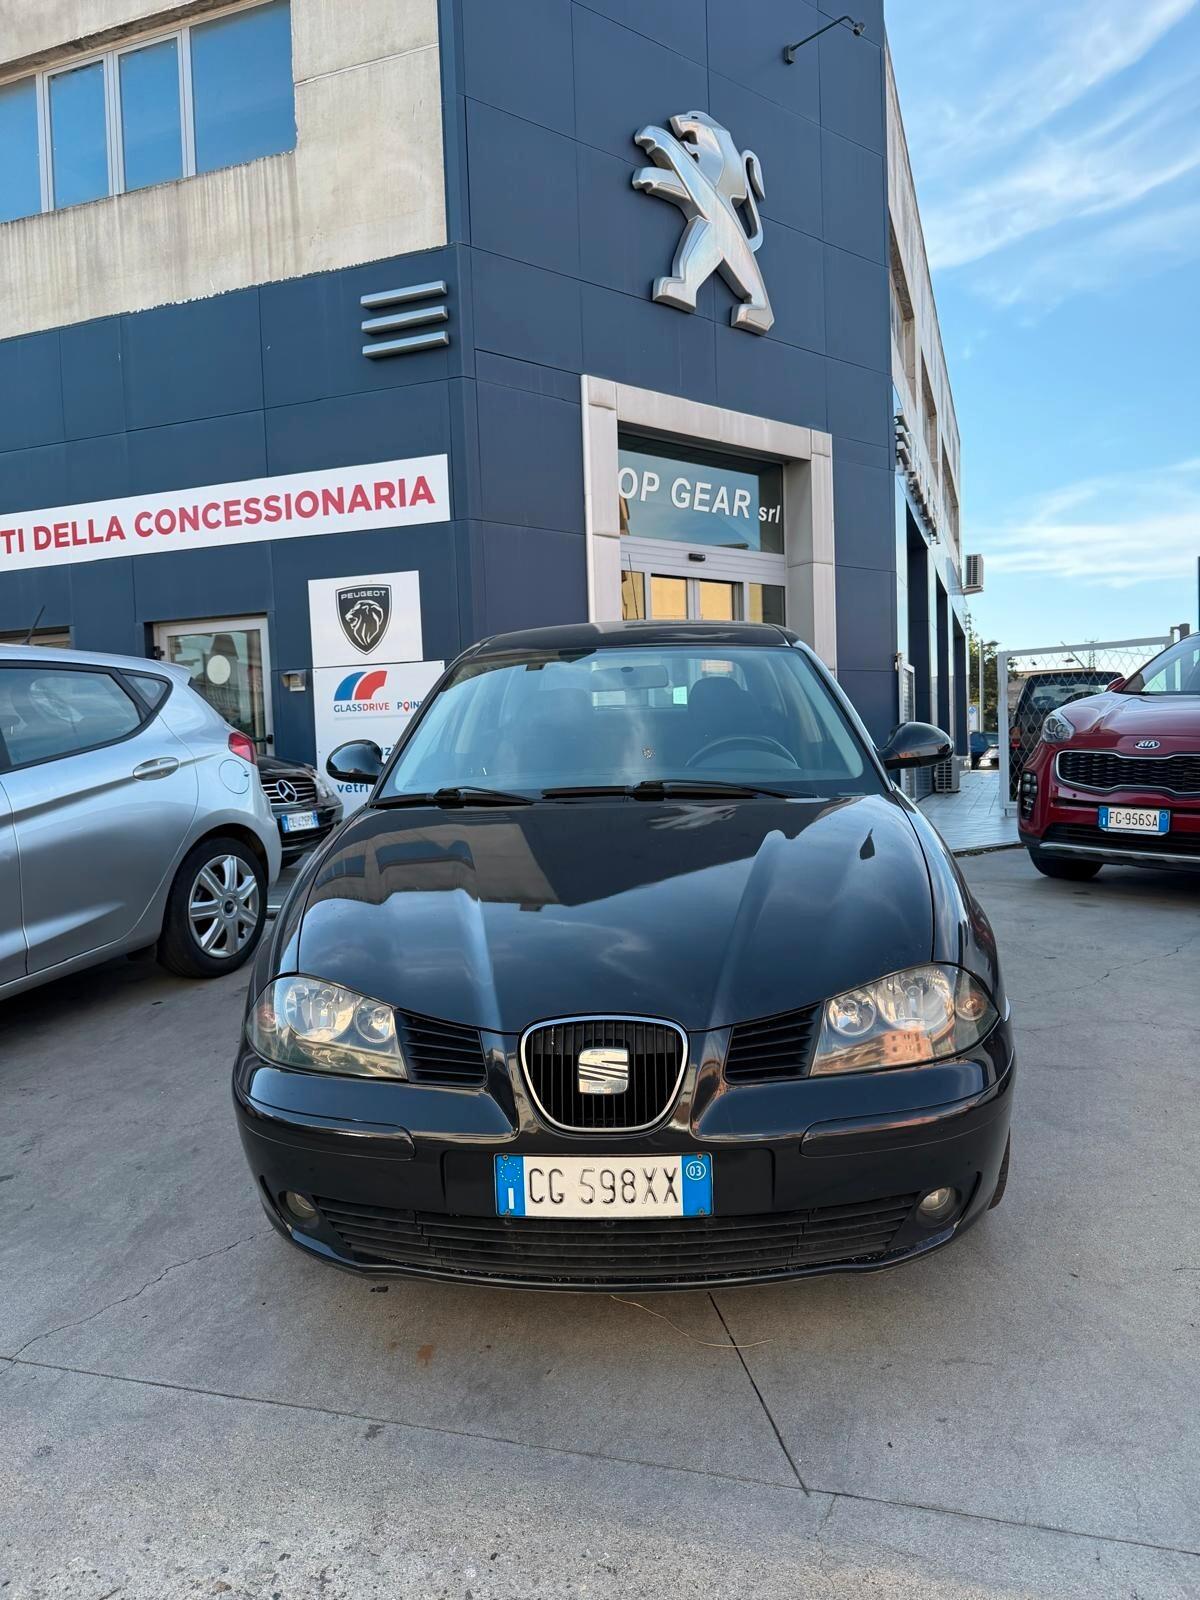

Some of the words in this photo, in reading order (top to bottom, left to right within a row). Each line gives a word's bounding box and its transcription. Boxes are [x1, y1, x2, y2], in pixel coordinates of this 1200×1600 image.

[671, 477, 751, 518] GEAR
[758, 505, 781, 523] srl
[33, 515, 126, 551] DELLA
[134, 475, 435, 538] CONCESSIONARIA
[340, 590, 386, 600] PEUGEOT
[333, 702, 390, 713] GLASSDRIVE
[1137, 740, 1156, 748] KIA
[528, 1168, 566, 1204] CG
[579, 1168, 679, 1204] 598XX
[689, 1164, 702, 1177] 03
